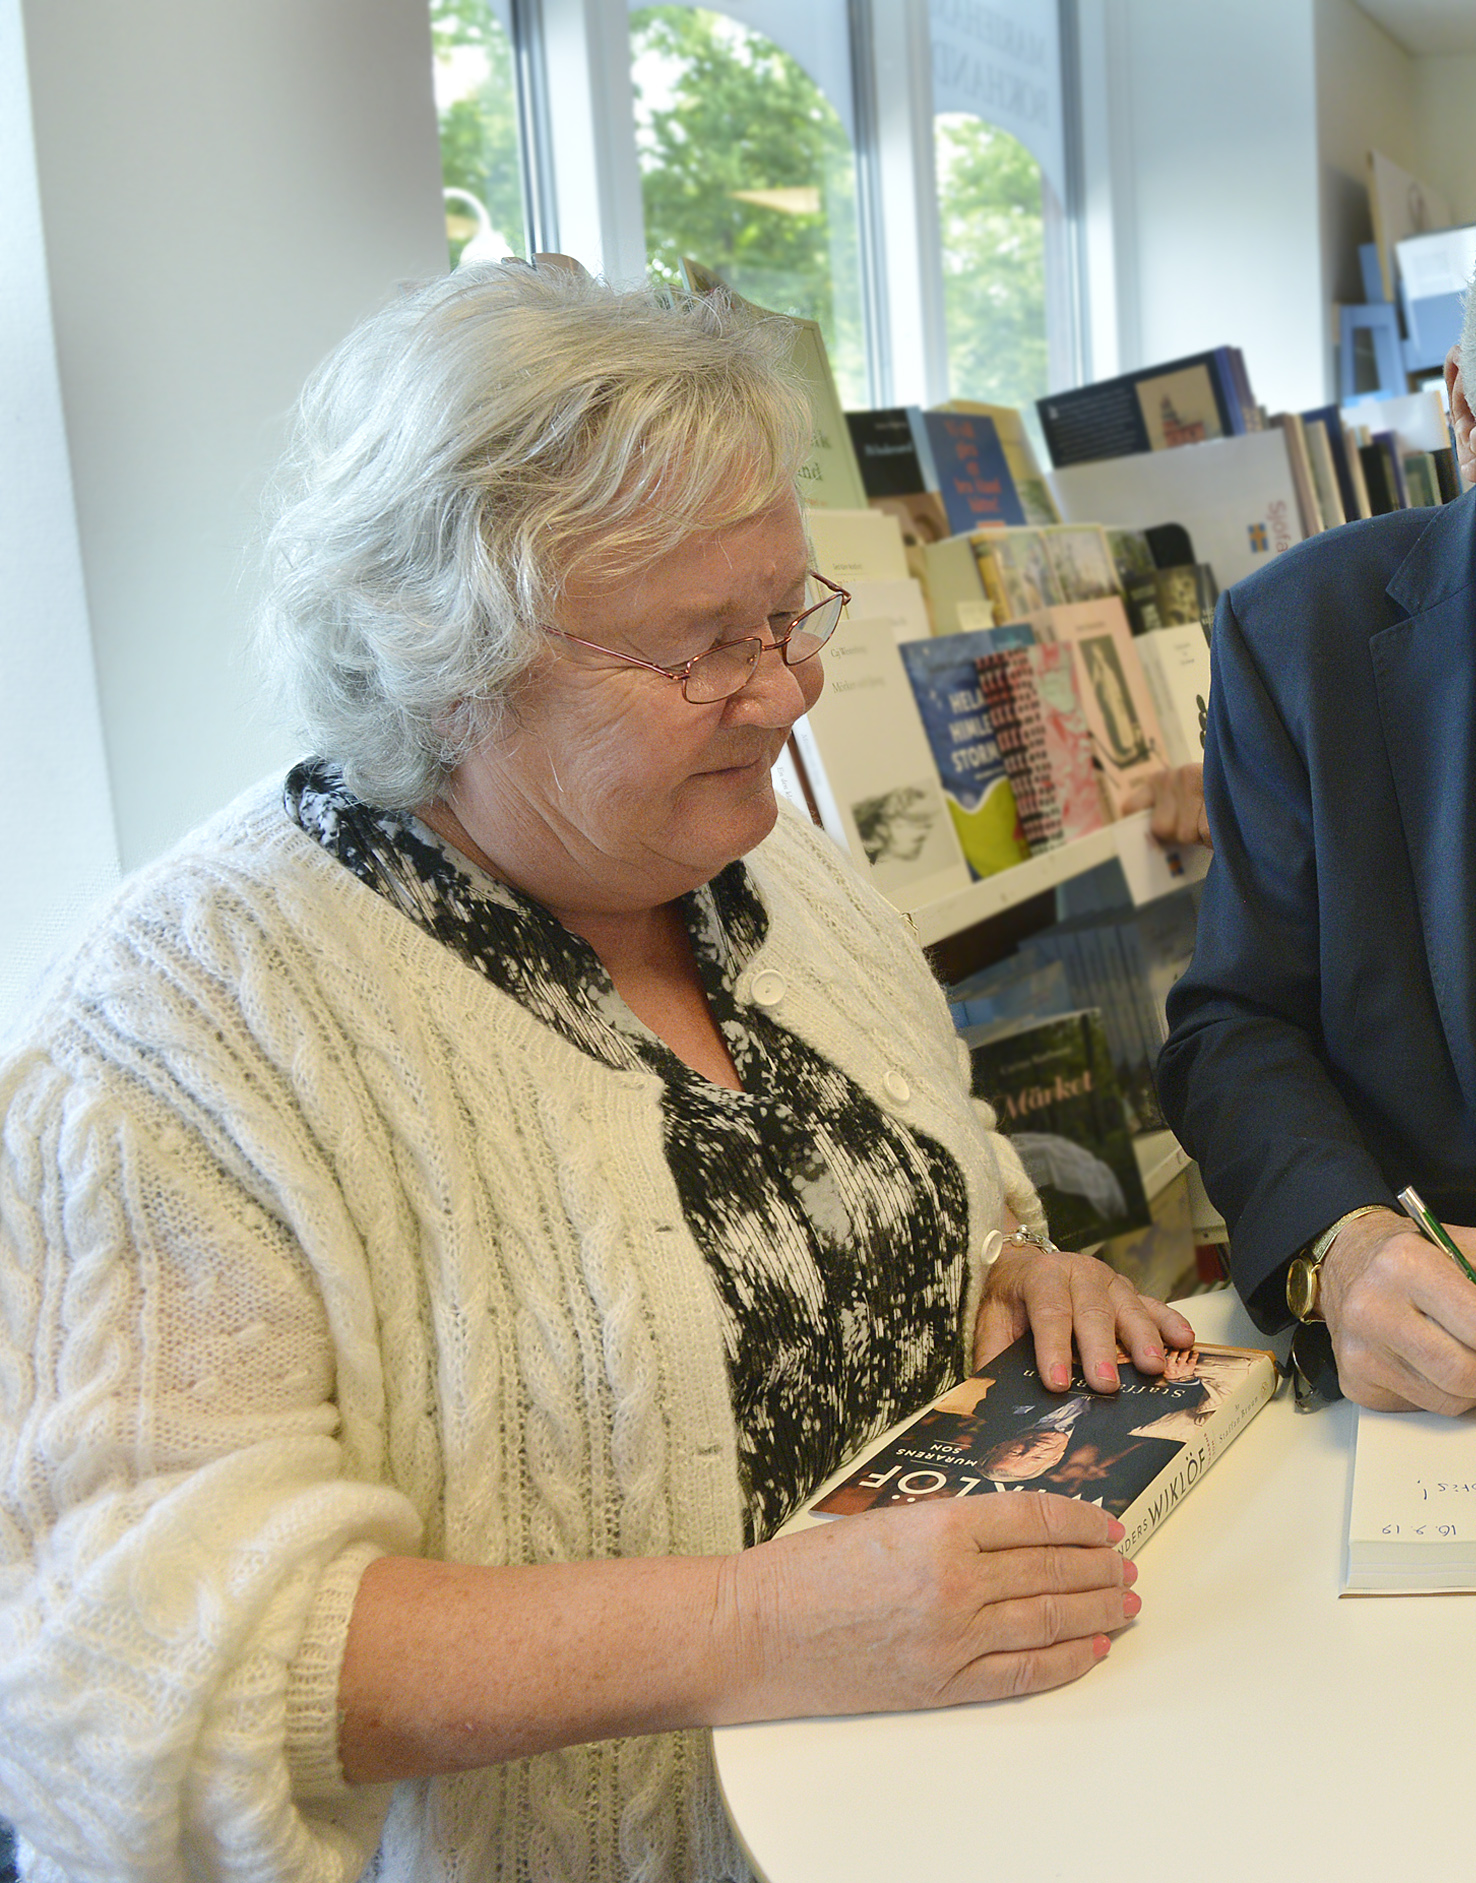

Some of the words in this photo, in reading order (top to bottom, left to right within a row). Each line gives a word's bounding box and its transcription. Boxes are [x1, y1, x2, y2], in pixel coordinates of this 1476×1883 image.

[996, 1070, 1094, 1120] Märket
[1119, 1382, 1186, 1399] Staffa
[895, 1448, 978, 1467] MURARENS
[930, 1443, 962, 1455] SON
[1117, 1517, 1148, 1556] NDERS
[1147, 1447, 1206, 1528] WIKLÖF
